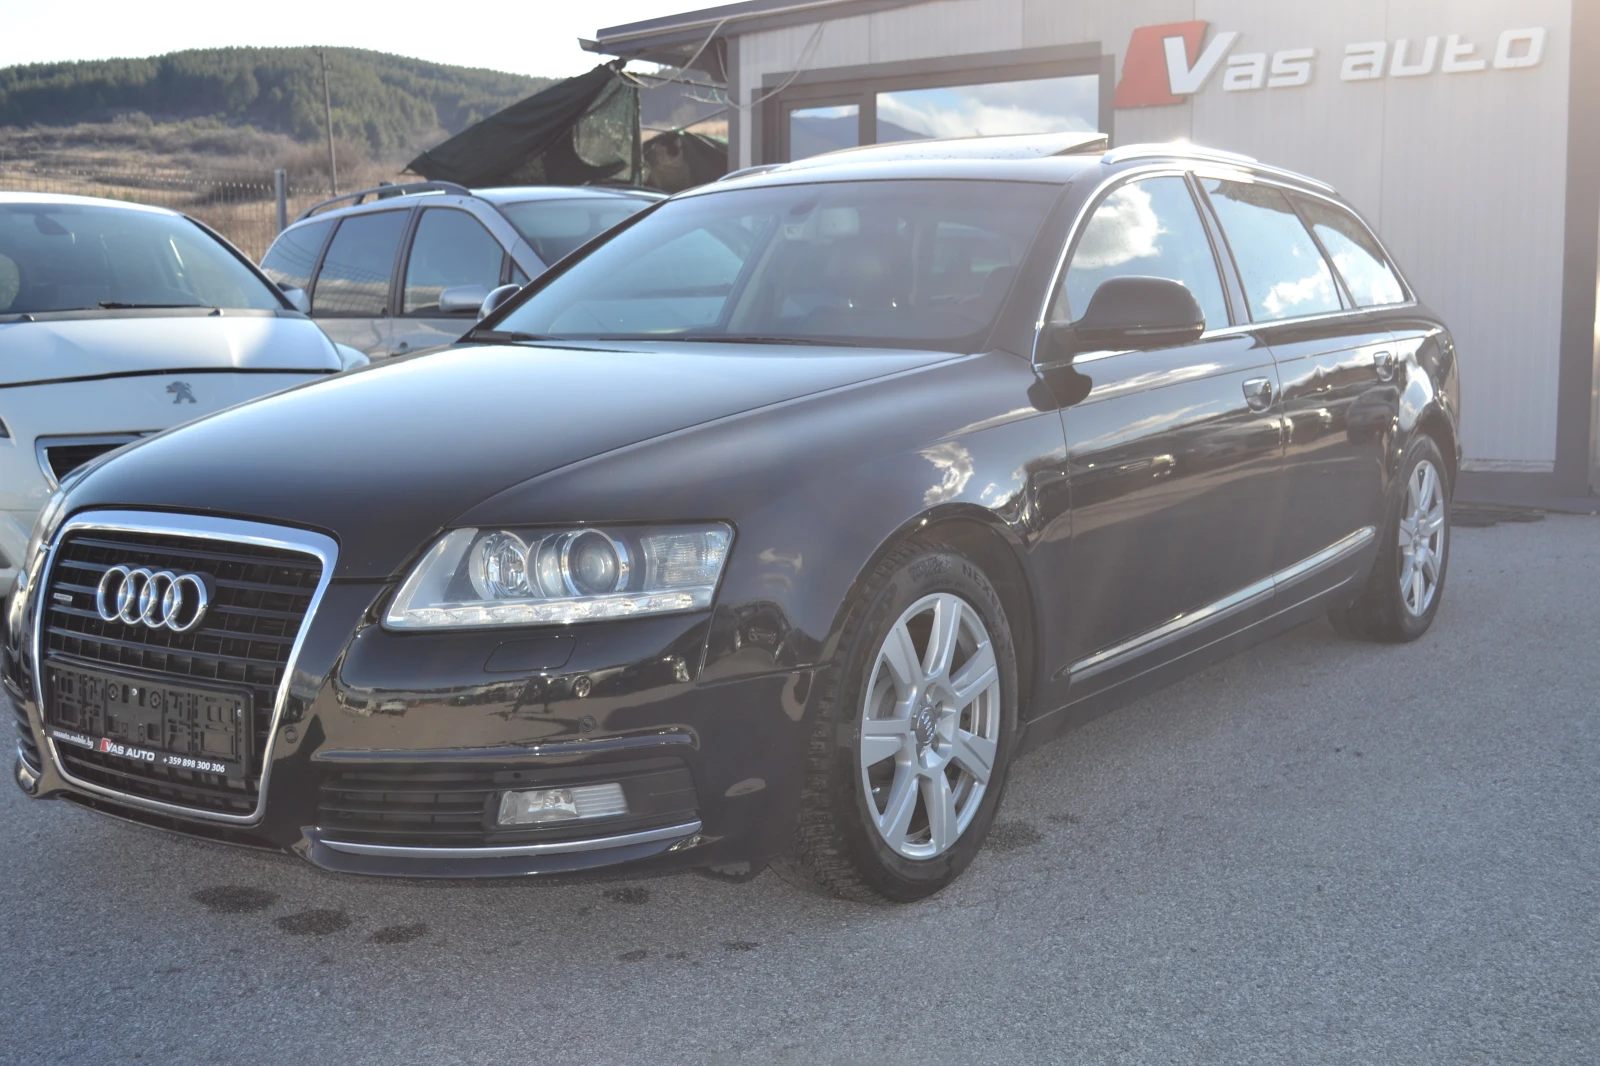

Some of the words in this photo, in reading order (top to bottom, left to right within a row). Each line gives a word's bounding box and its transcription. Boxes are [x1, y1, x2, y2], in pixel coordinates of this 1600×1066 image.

[1162, 31, 1317, 95] Vas
[1339, 26, 1547, 82] auto
[106, 741, 125, 755] VAS
[126, 748, 155, 761] AUTO
[168, 756, 182, 765] 359
[182, 758, 196, 768] 898
[197, 760, 211, 770] 300
[211, 763, 225, 773] 306
